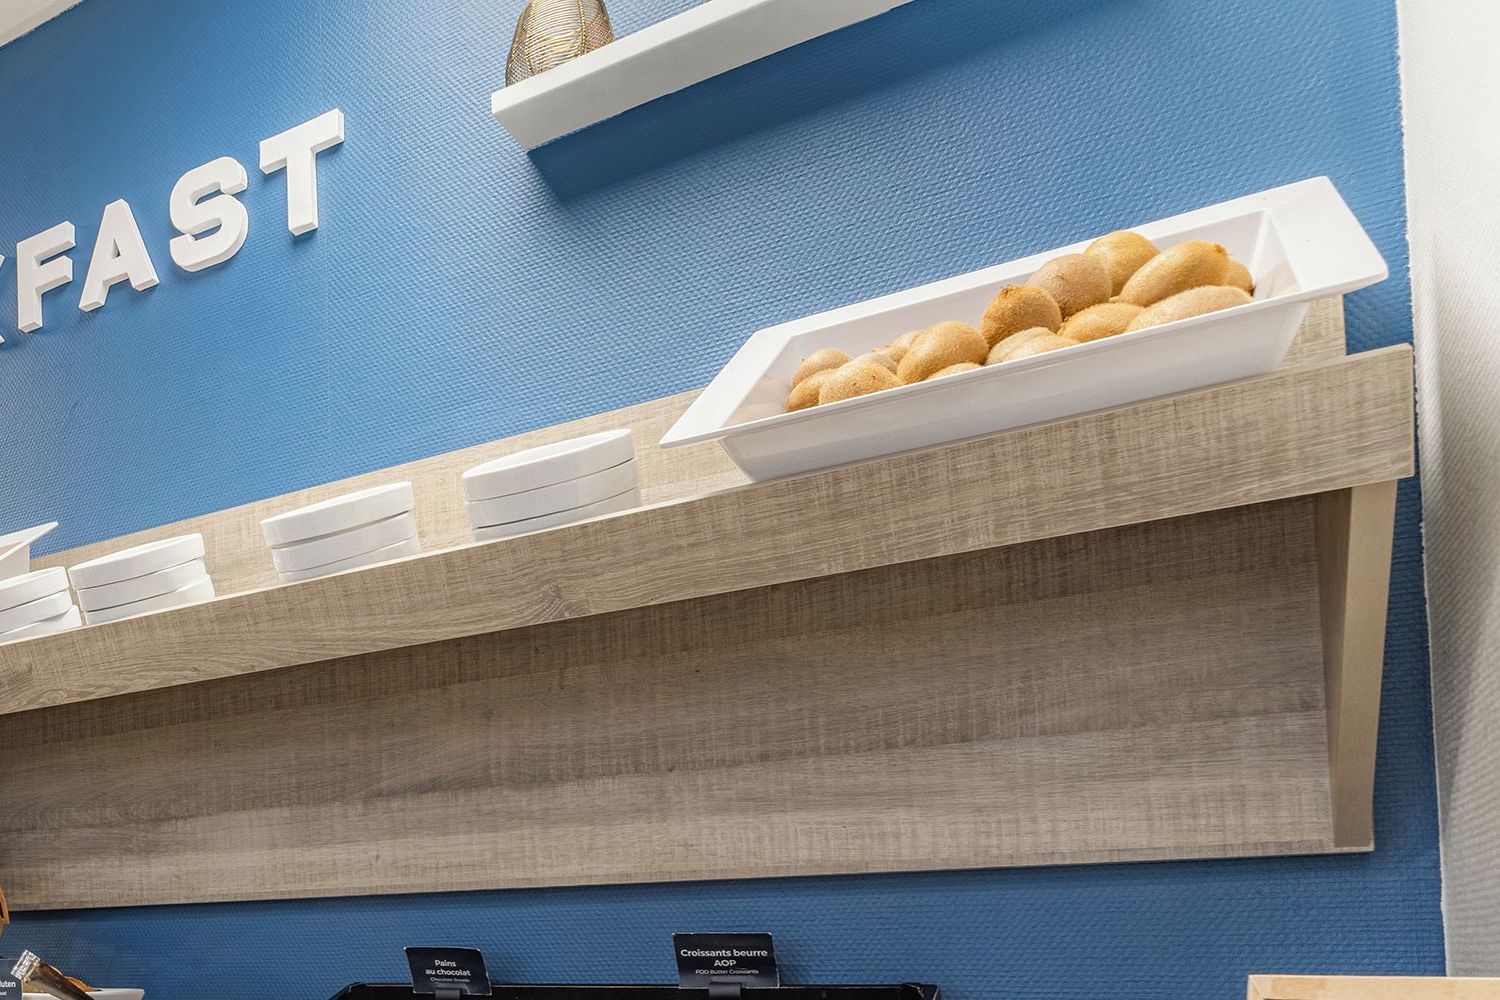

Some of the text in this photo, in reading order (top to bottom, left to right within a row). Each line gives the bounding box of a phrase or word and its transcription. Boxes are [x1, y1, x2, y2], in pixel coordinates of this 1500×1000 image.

[680, 948, 768, 957] Croissants beurre
[434, 959, 457, 968] Pains
[713, 959, 737, 967] AOP
[436, 968, 471, 976] chocolat
